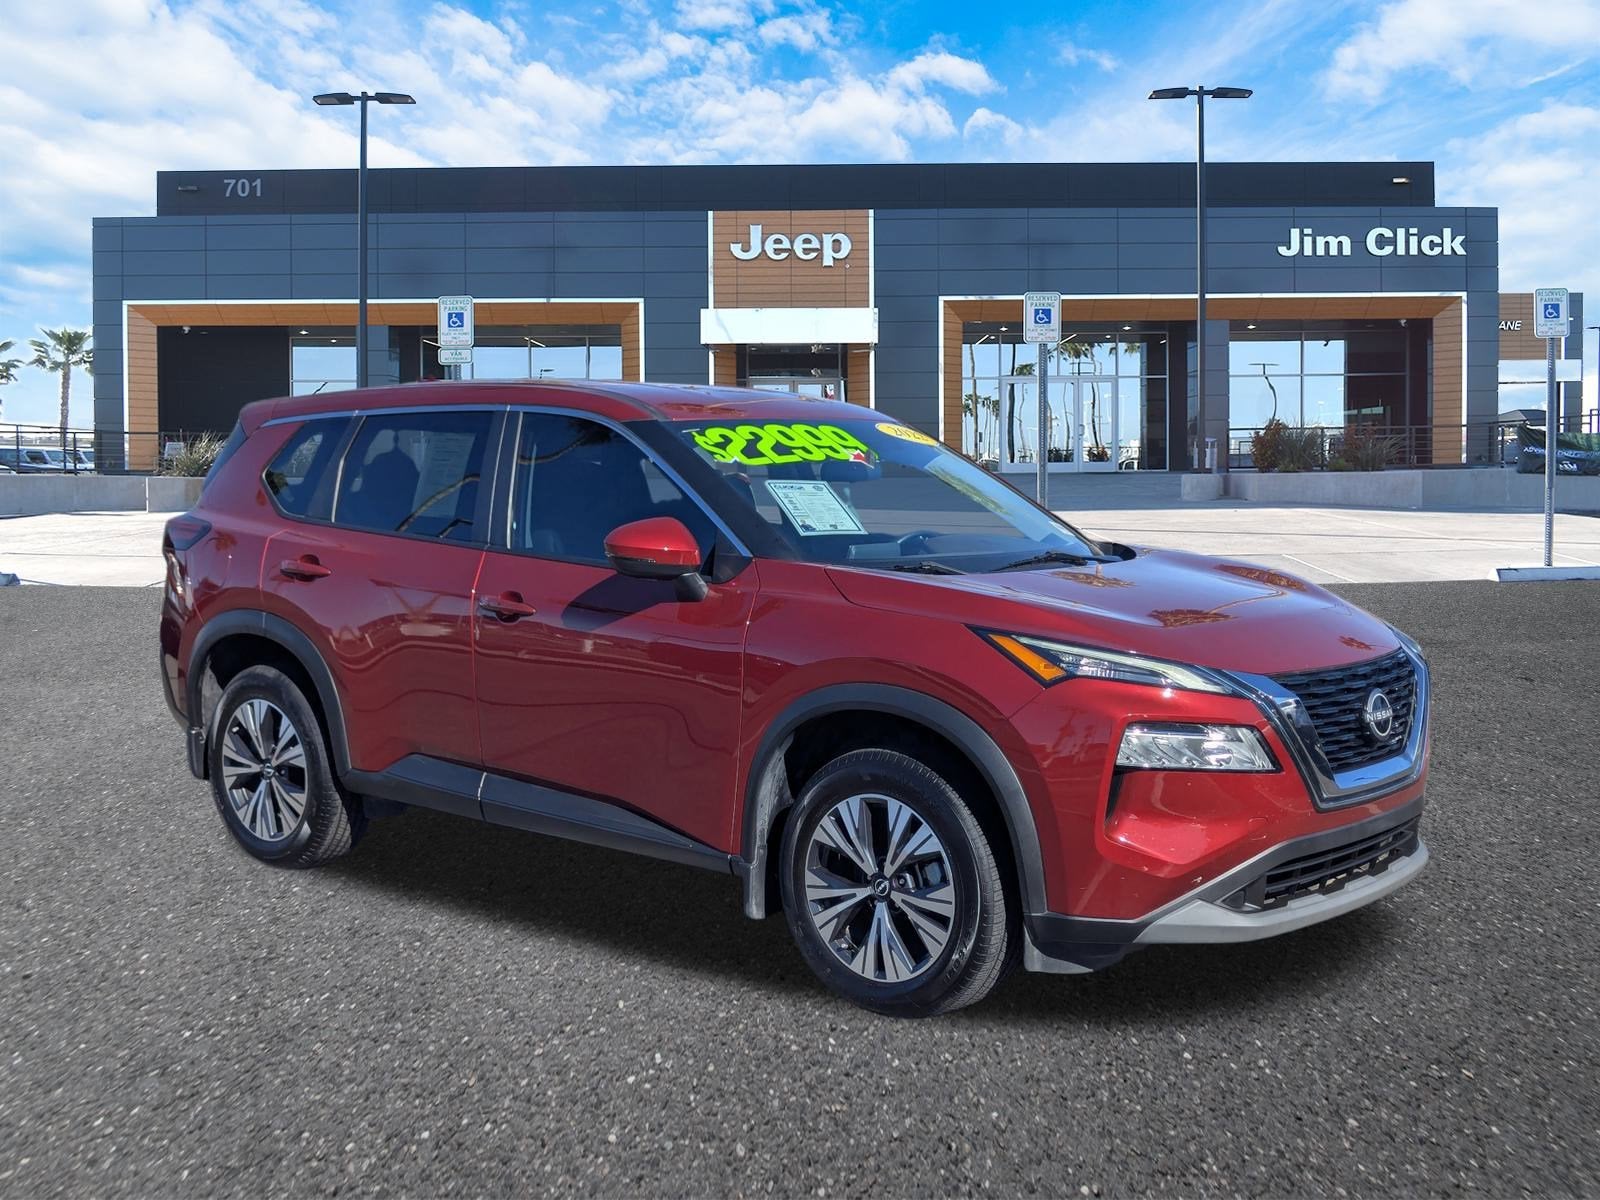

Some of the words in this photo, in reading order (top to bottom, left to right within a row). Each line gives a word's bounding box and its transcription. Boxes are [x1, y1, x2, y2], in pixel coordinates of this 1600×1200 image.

[223, 178, 262, 197] 701
[729, 224, 853, 267] Jeep
[1277, 228, 1352, 257] Jim
[1365, 227, 1467, 256] Click
[692, 424, 878, 466] $22999
